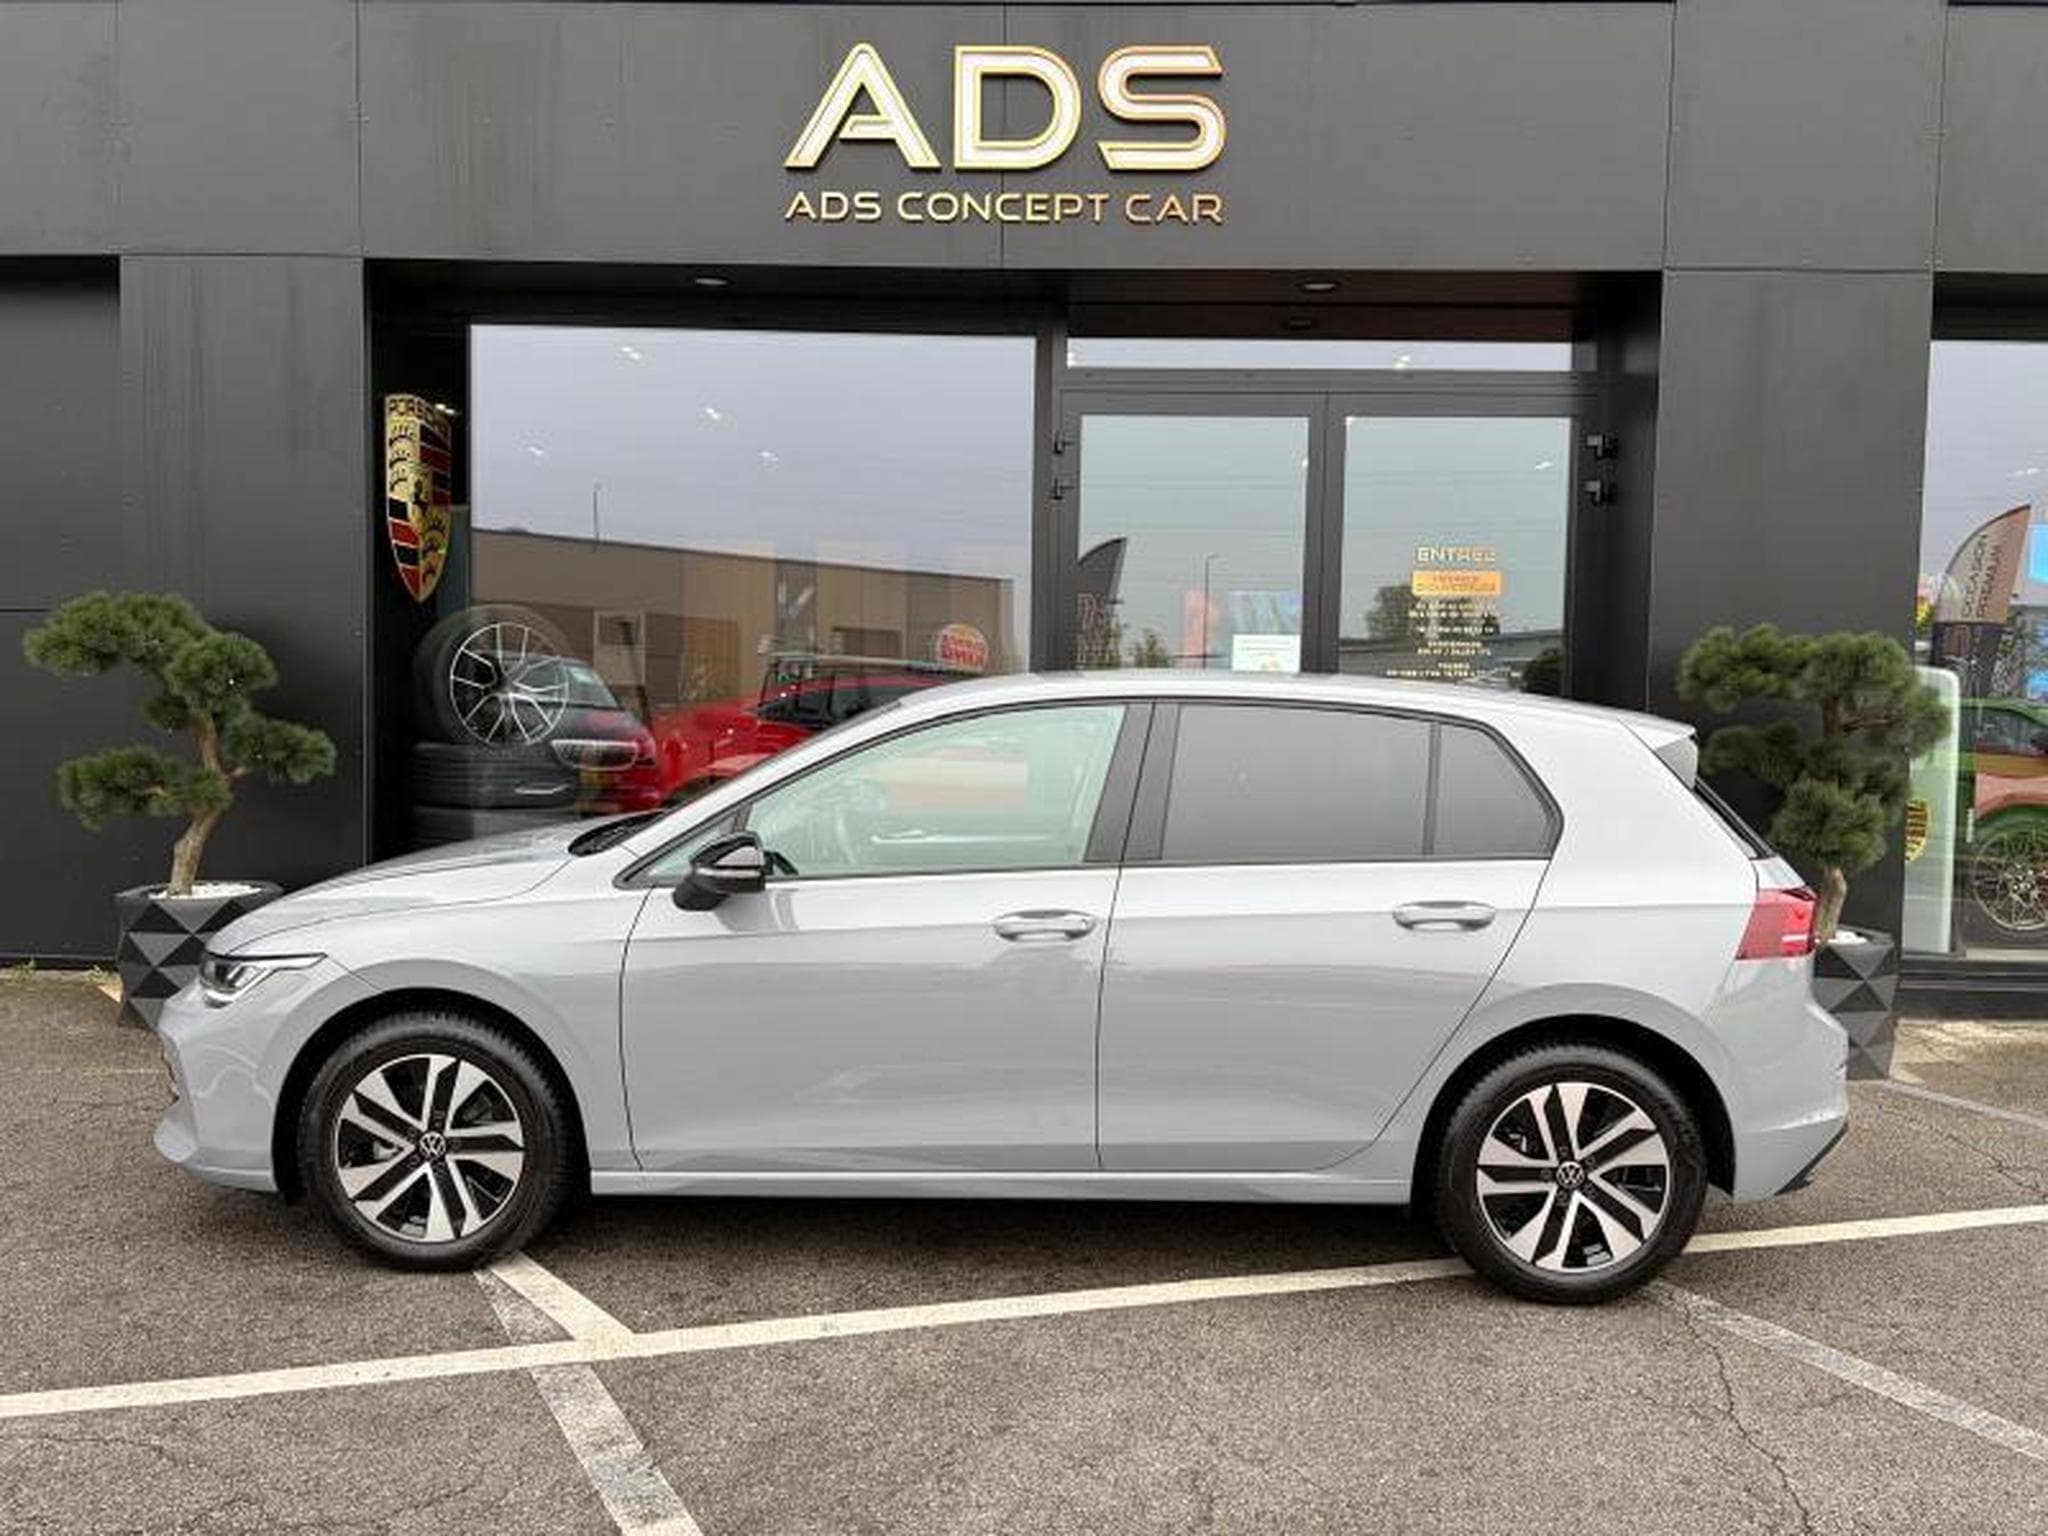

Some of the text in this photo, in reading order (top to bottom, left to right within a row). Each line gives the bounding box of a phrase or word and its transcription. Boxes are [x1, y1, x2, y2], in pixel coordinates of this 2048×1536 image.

[784, 42, 1227, 171] ADS
[784, 192, 1224, 224] ADS CONCEPT CAR
